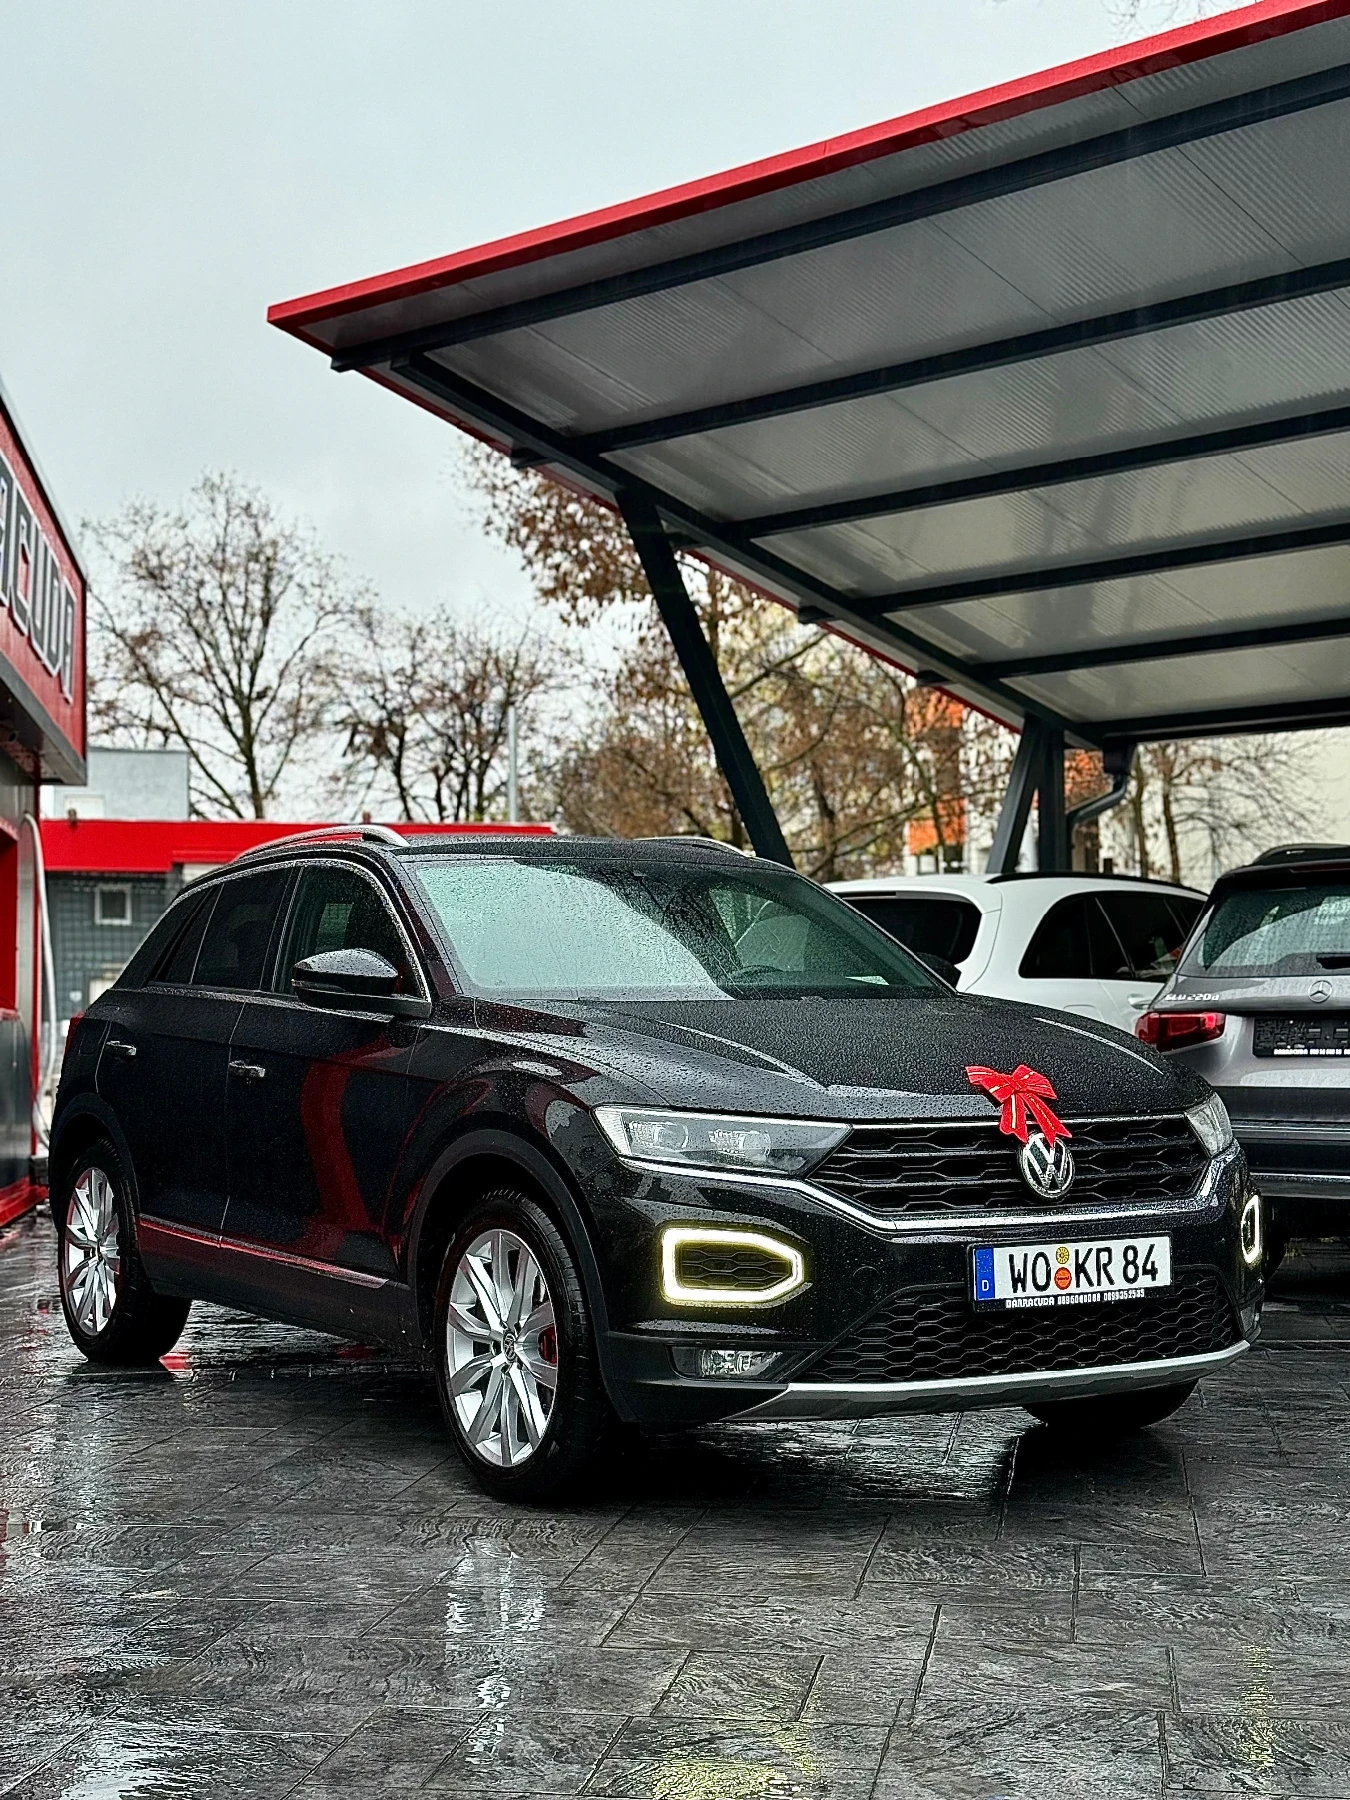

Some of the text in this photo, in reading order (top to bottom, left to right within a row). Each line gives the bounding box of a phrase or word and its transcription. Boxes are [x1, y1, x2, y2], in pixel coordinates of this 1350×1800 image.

[981, 1279, 989, 1291] D
[1008, 1252, 1051, 1294] WO
[1074, 1246, 1115, 1288] KR
[1122, 1243, 1159, 1285] 84
[1005, 1297, 1055, 1308] BARRACUDA
